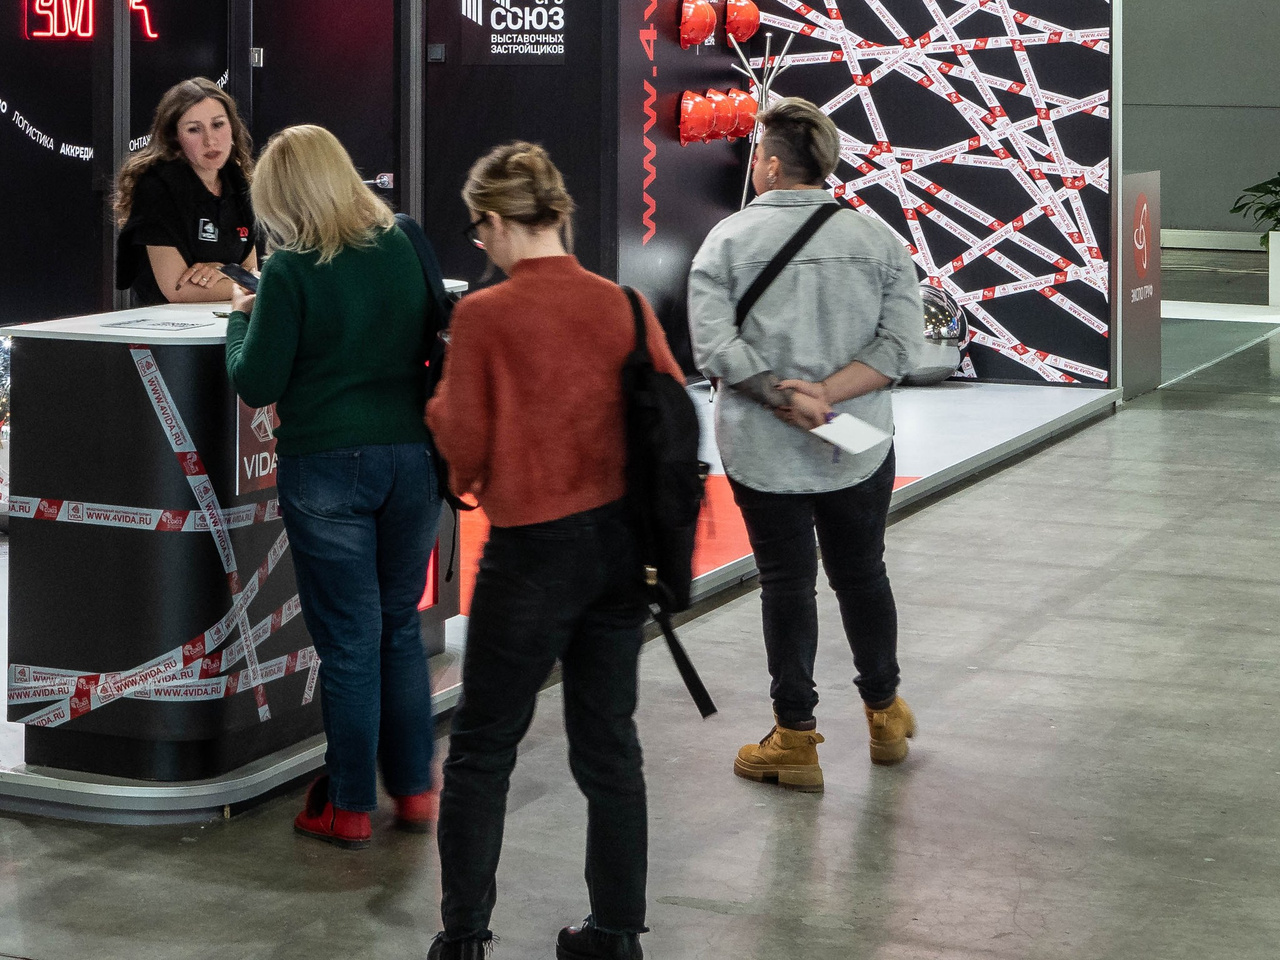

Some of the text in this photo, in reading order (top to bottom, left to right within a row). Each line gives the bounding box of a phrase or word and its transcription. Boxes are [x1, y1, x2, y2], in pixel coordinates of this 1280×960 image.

[490, 7, 565, 30] СОЮЗ
[491, 34, 564, 43] ВЫСТАВОЧНЫХ
[490, 43, 564, 55] ЗАСТРОЙЩИКОВ
[12, 110, 55, 150] ЛОГИСТИКА
[147, 377, 183, 446] WWW.4VIDA.RU
[86, 512, 152, 525] WWW.4VIDA.RU
[114, 660, 177, 693] WWW.4VIDA.RU
[8, 687, 69, 699] WWW.4VIDA.RU
[154, 686, 221, 697] WWW.4VIDA.RU
